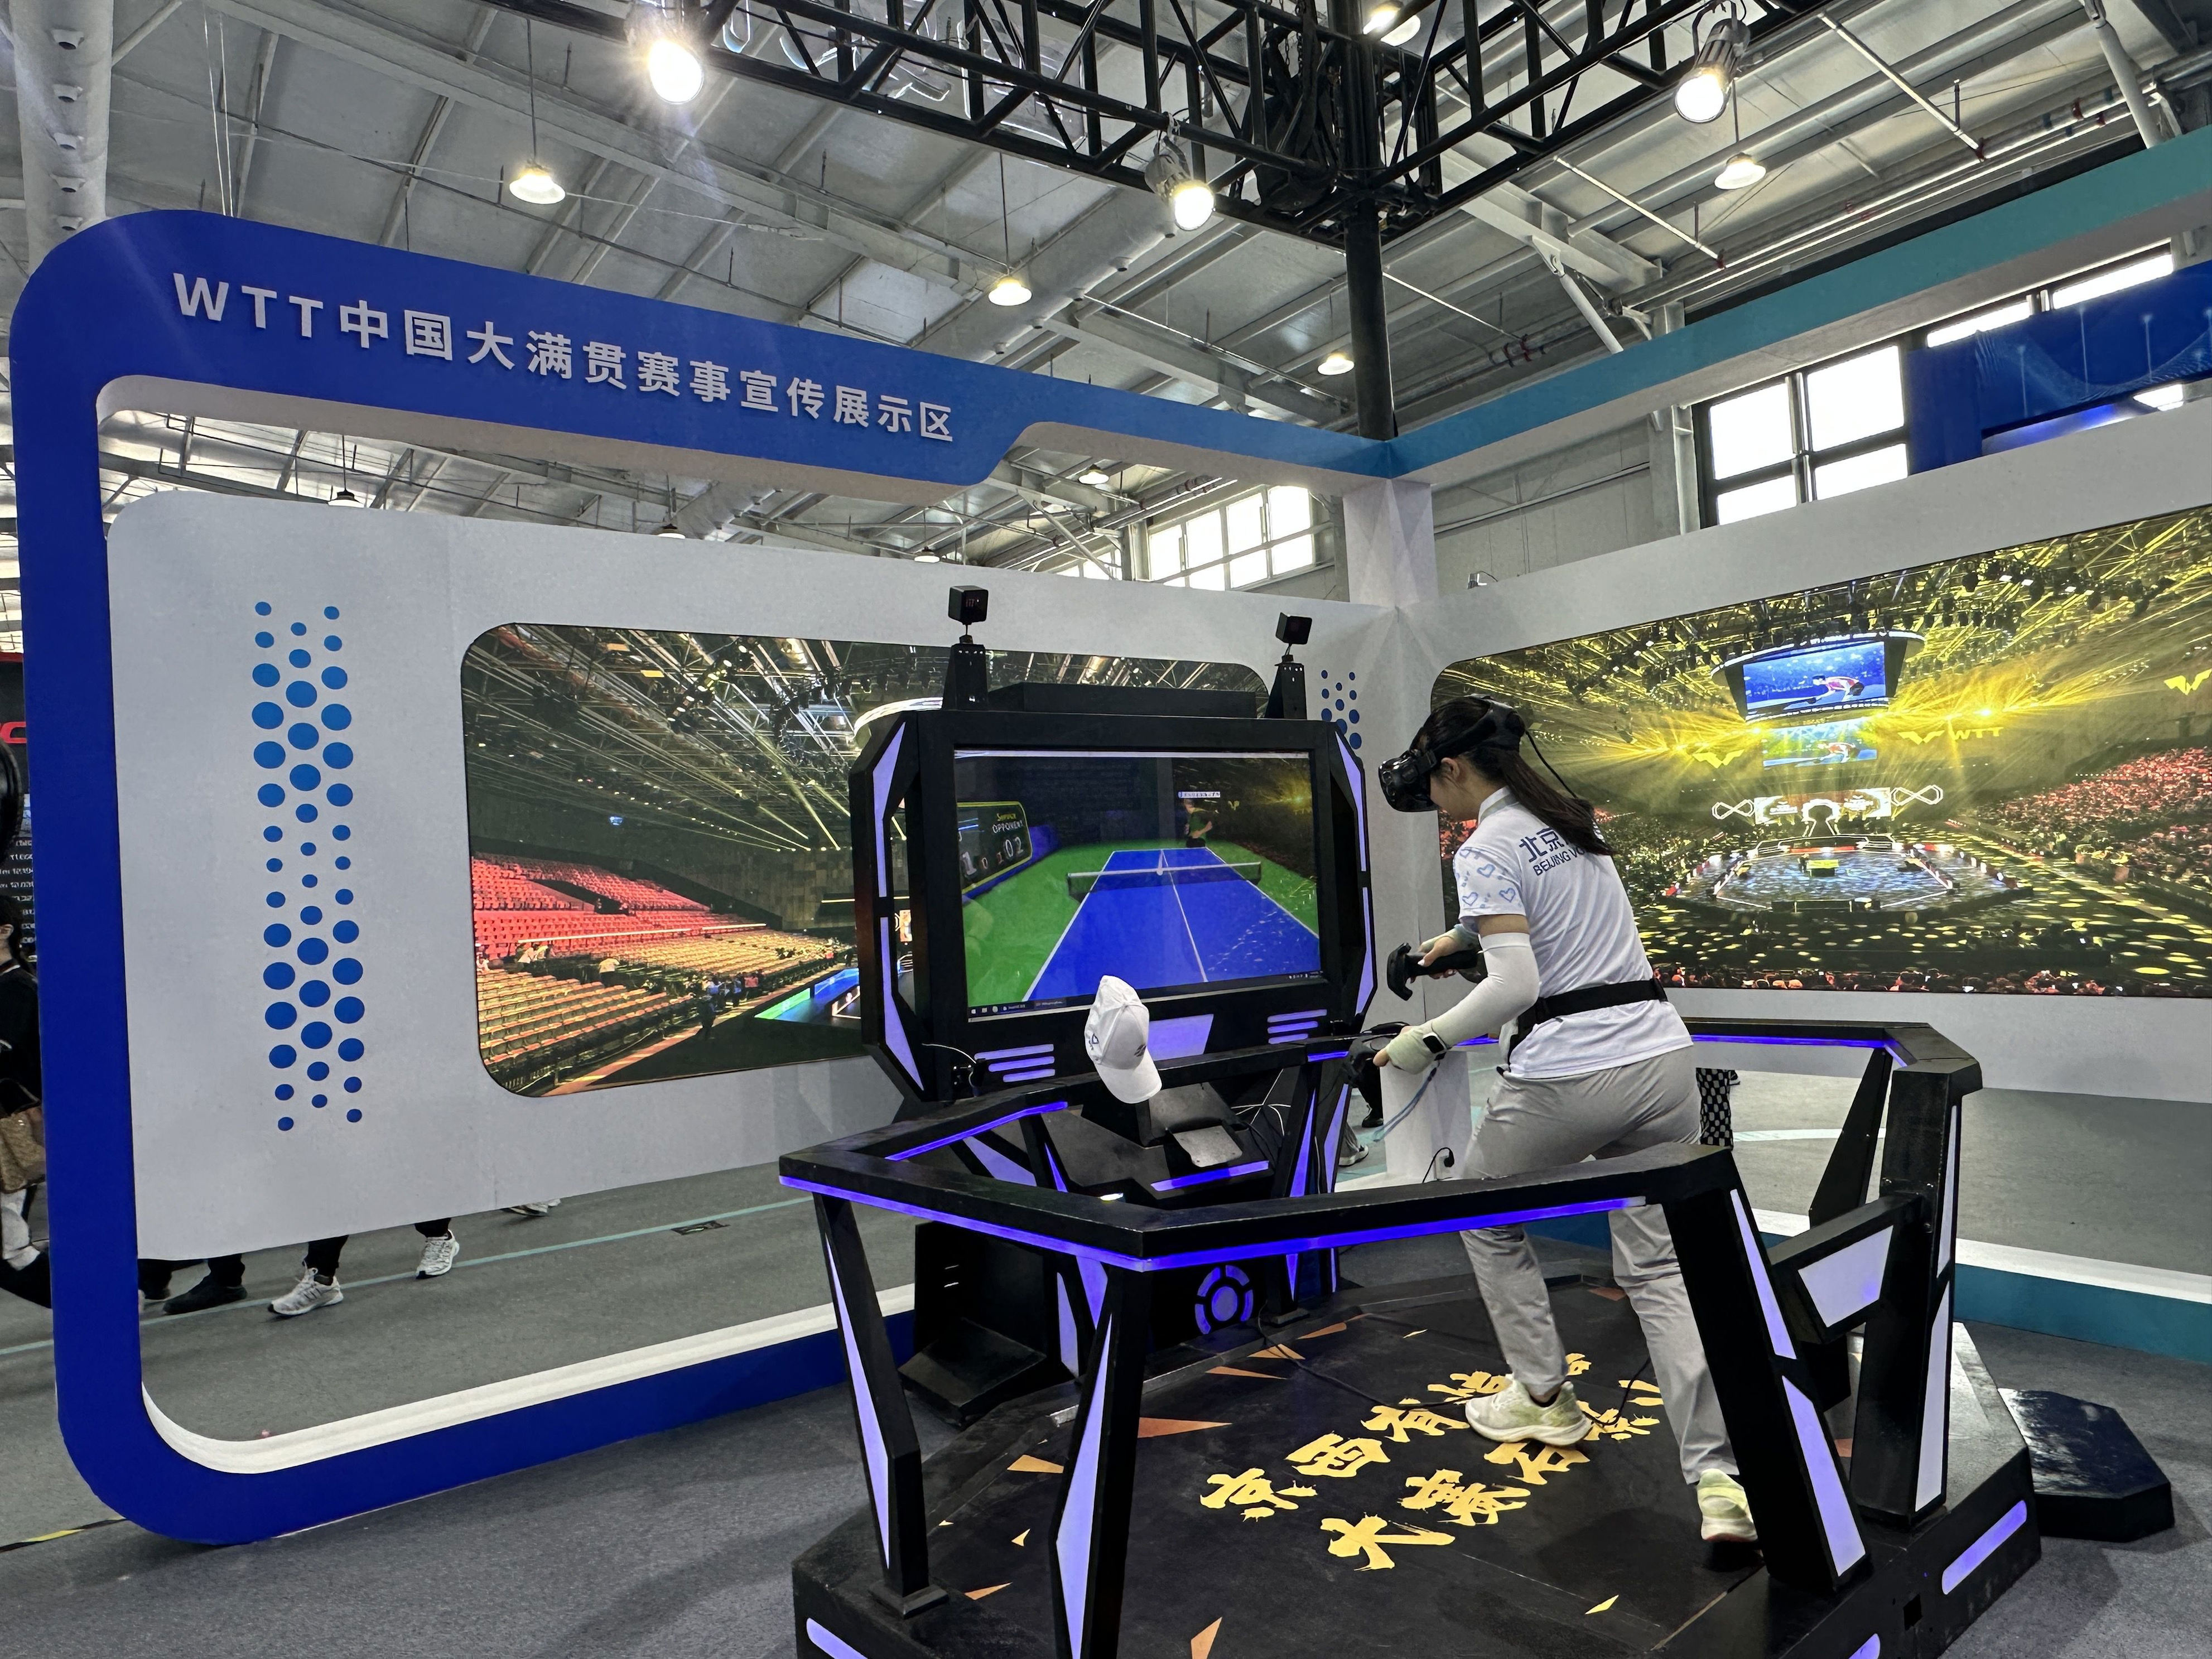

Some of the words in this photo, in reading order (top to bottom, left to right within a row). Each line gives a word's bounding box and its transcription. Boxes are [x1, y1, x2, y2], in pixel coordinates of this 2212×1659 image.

[172, 272, 953, 442] WTT中国大满贯赛事宣传展示区
[1948, 727, 2004, 740] WTT
[1519, 826, 1569, 863] 北京
[1533, 851, 1572, 876] BEIJING
